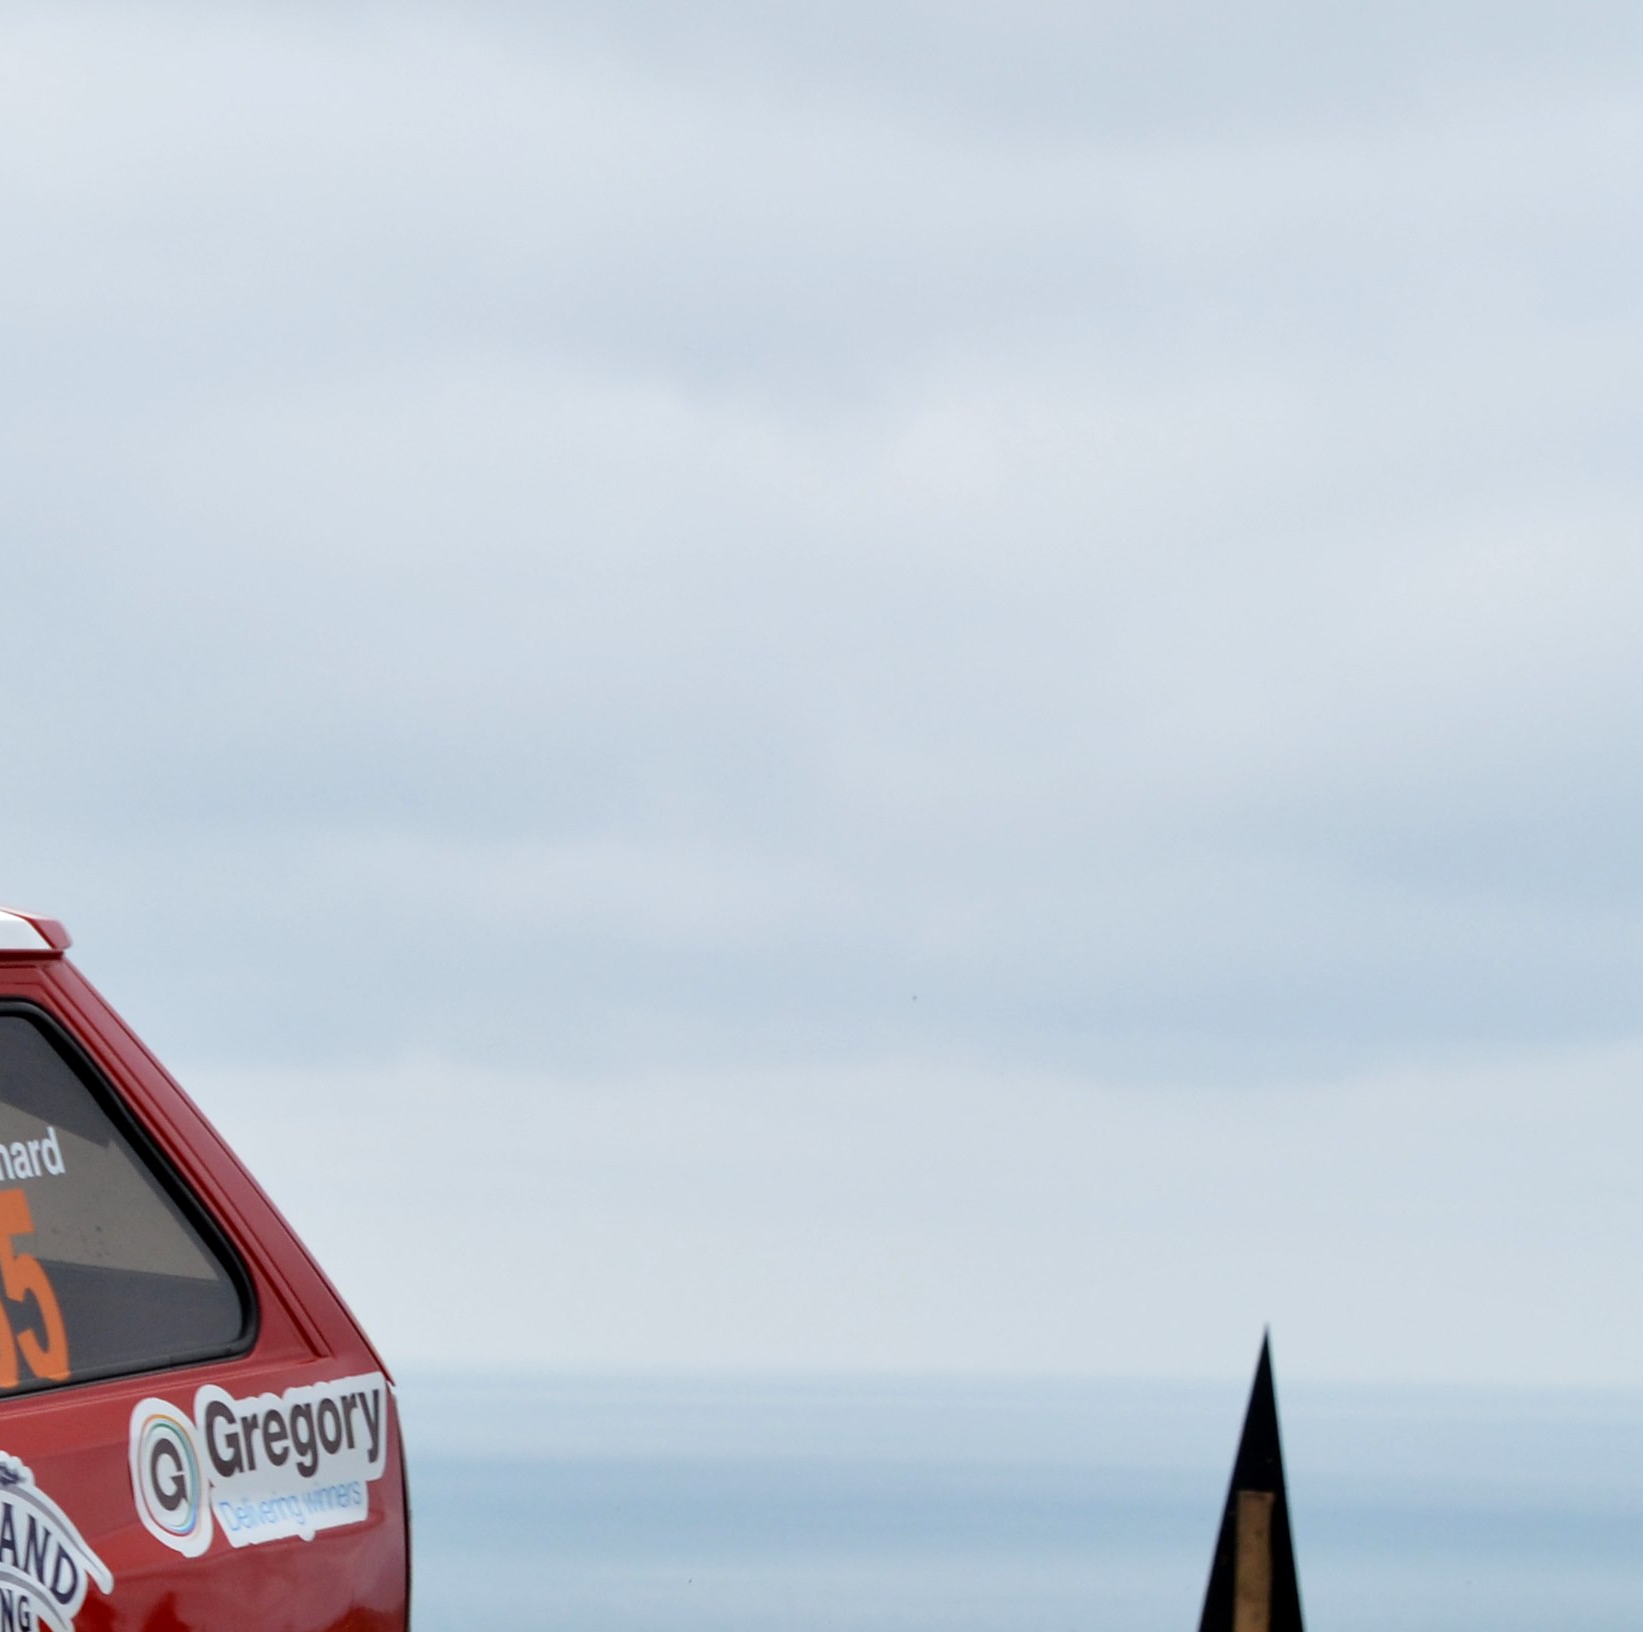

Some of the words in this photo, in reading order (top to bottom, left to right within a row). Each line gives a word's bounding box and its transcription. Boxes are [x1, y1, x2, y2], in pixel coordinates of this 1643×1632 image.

[205, 1389, 380, 1479] Gregory
[219, 1490, 306, 1533] Delivering
[305, 1481, 362, 1514] winners
